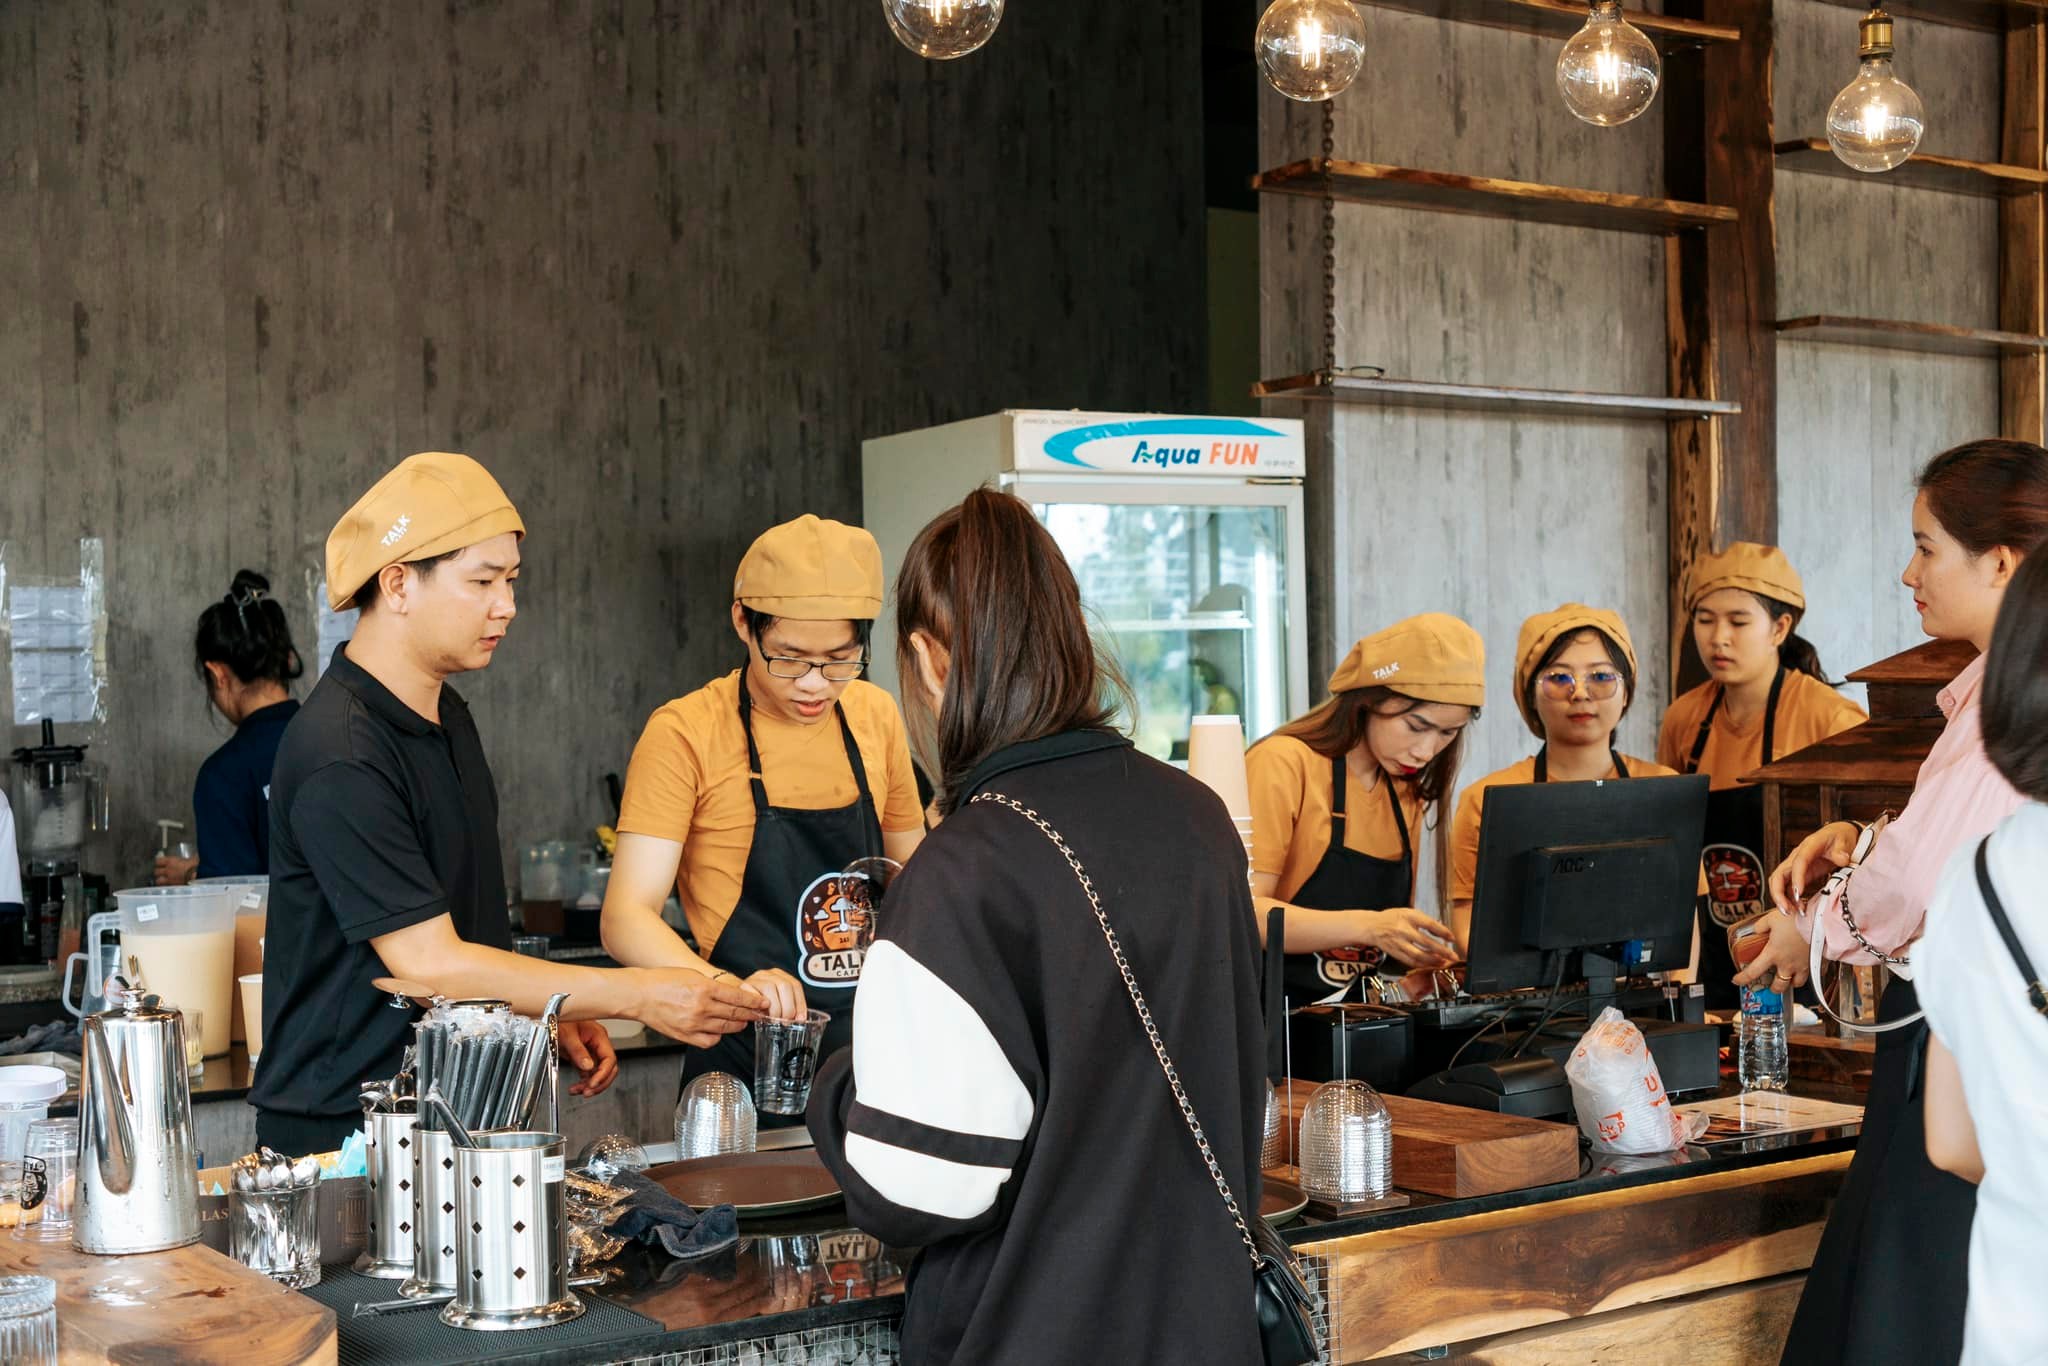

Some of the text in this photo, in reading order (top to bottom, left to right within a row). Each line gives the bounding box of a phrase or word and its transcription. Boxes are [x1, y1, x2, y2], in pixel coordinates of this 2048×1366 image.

[1131, 440, 1259, 468] Aqua FUN
[380, 514, 411, 547] TALK
[1372, 661, 1400, 680] TALK
[1717, 902, 1755, 917] TALK
[820, 953, 865, 972] TAL
